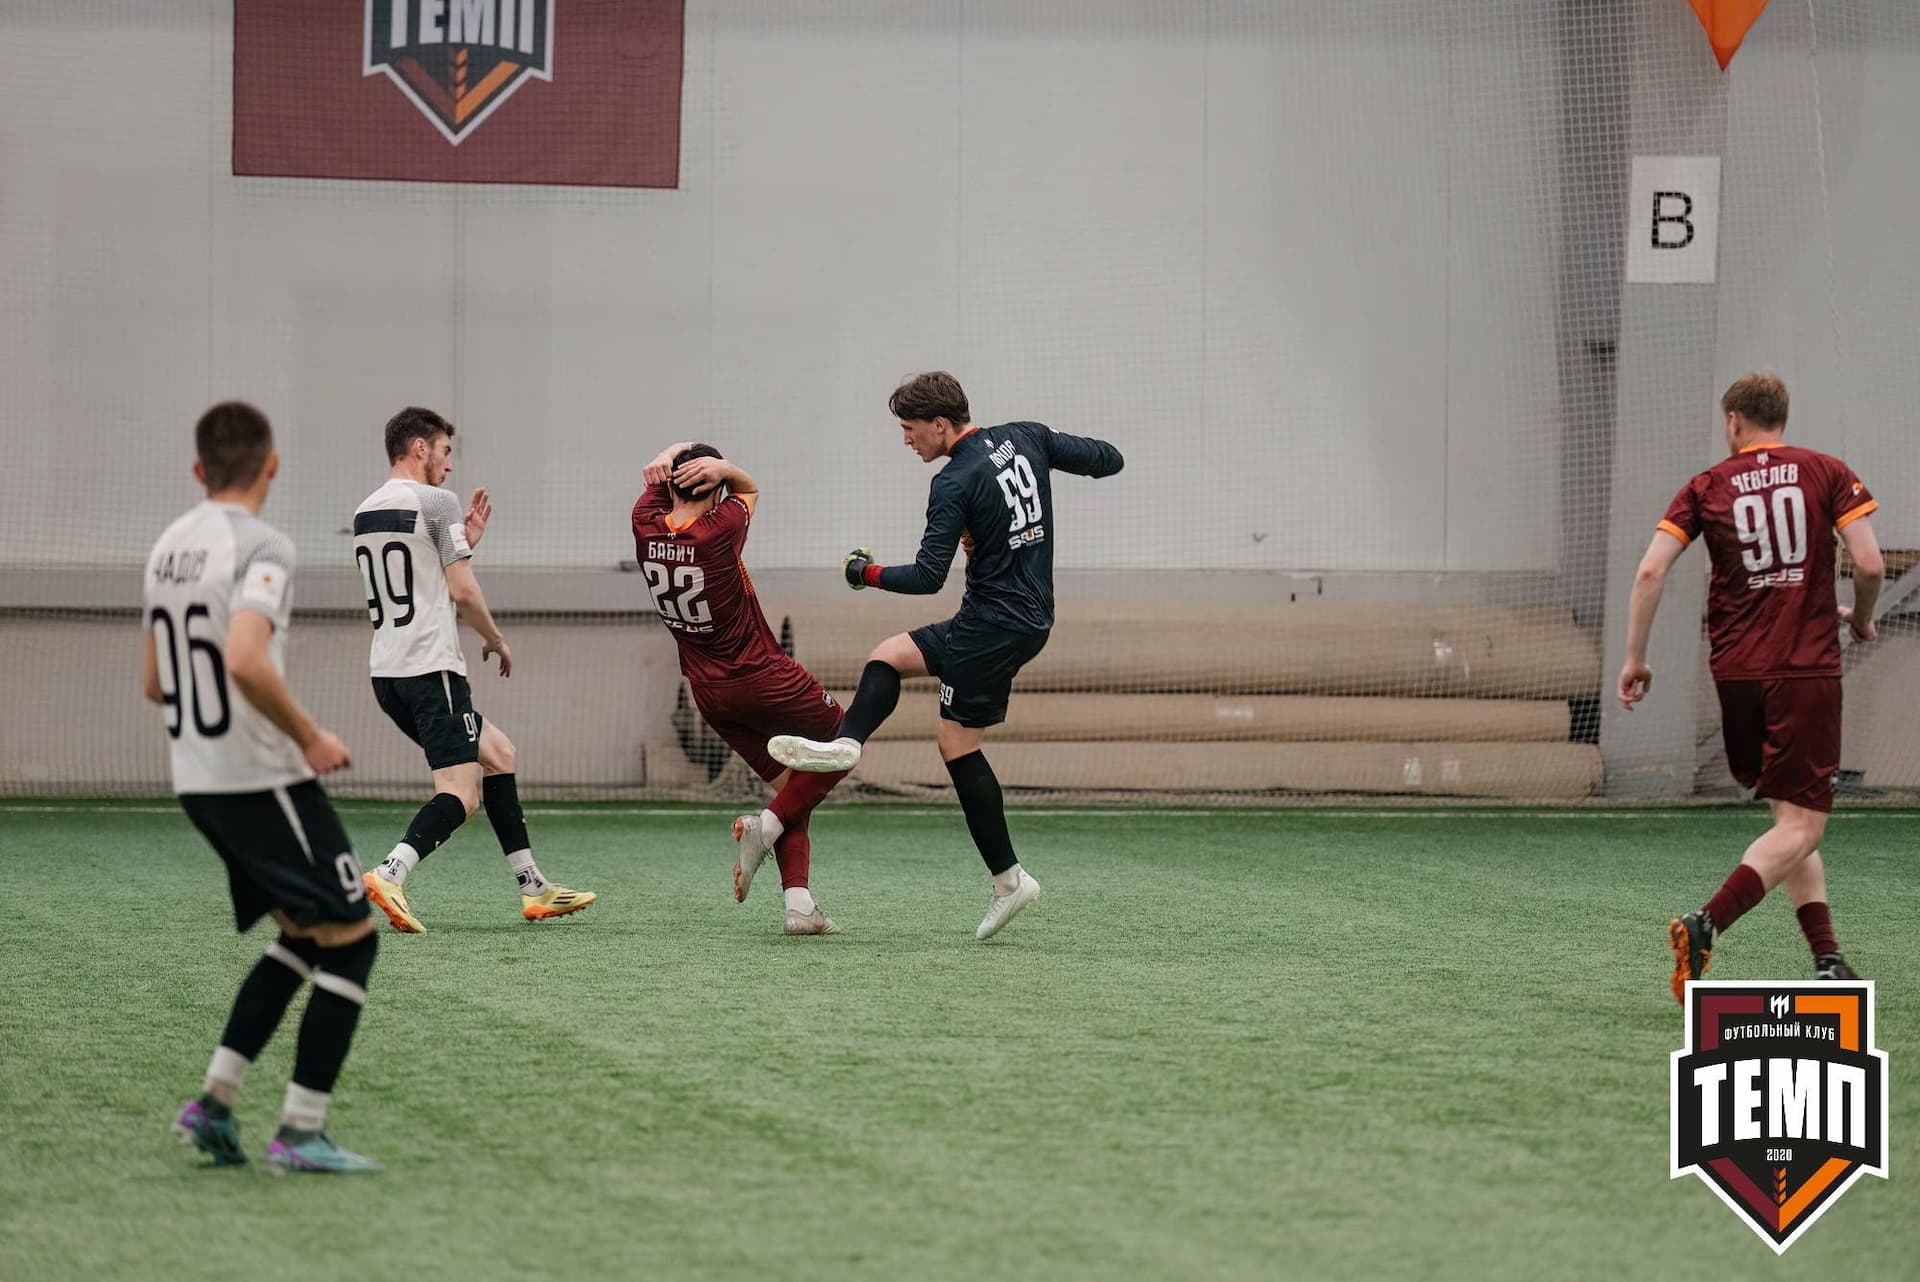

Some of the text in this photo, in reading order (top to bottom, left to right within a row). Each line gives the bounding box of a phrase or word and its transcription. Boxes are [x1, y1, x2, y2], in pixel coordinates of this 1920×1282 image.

[996, 454, 1042, 532] 59
[1731, 463, 1799, 493] ЧЕВЕЛЕВ
[648, 541, 695, 563] БАБИЧ
[1733, 486, 1808, 572] 90
[643, 561, 713, 624] 22
[151, 602, 230, 739] 96
